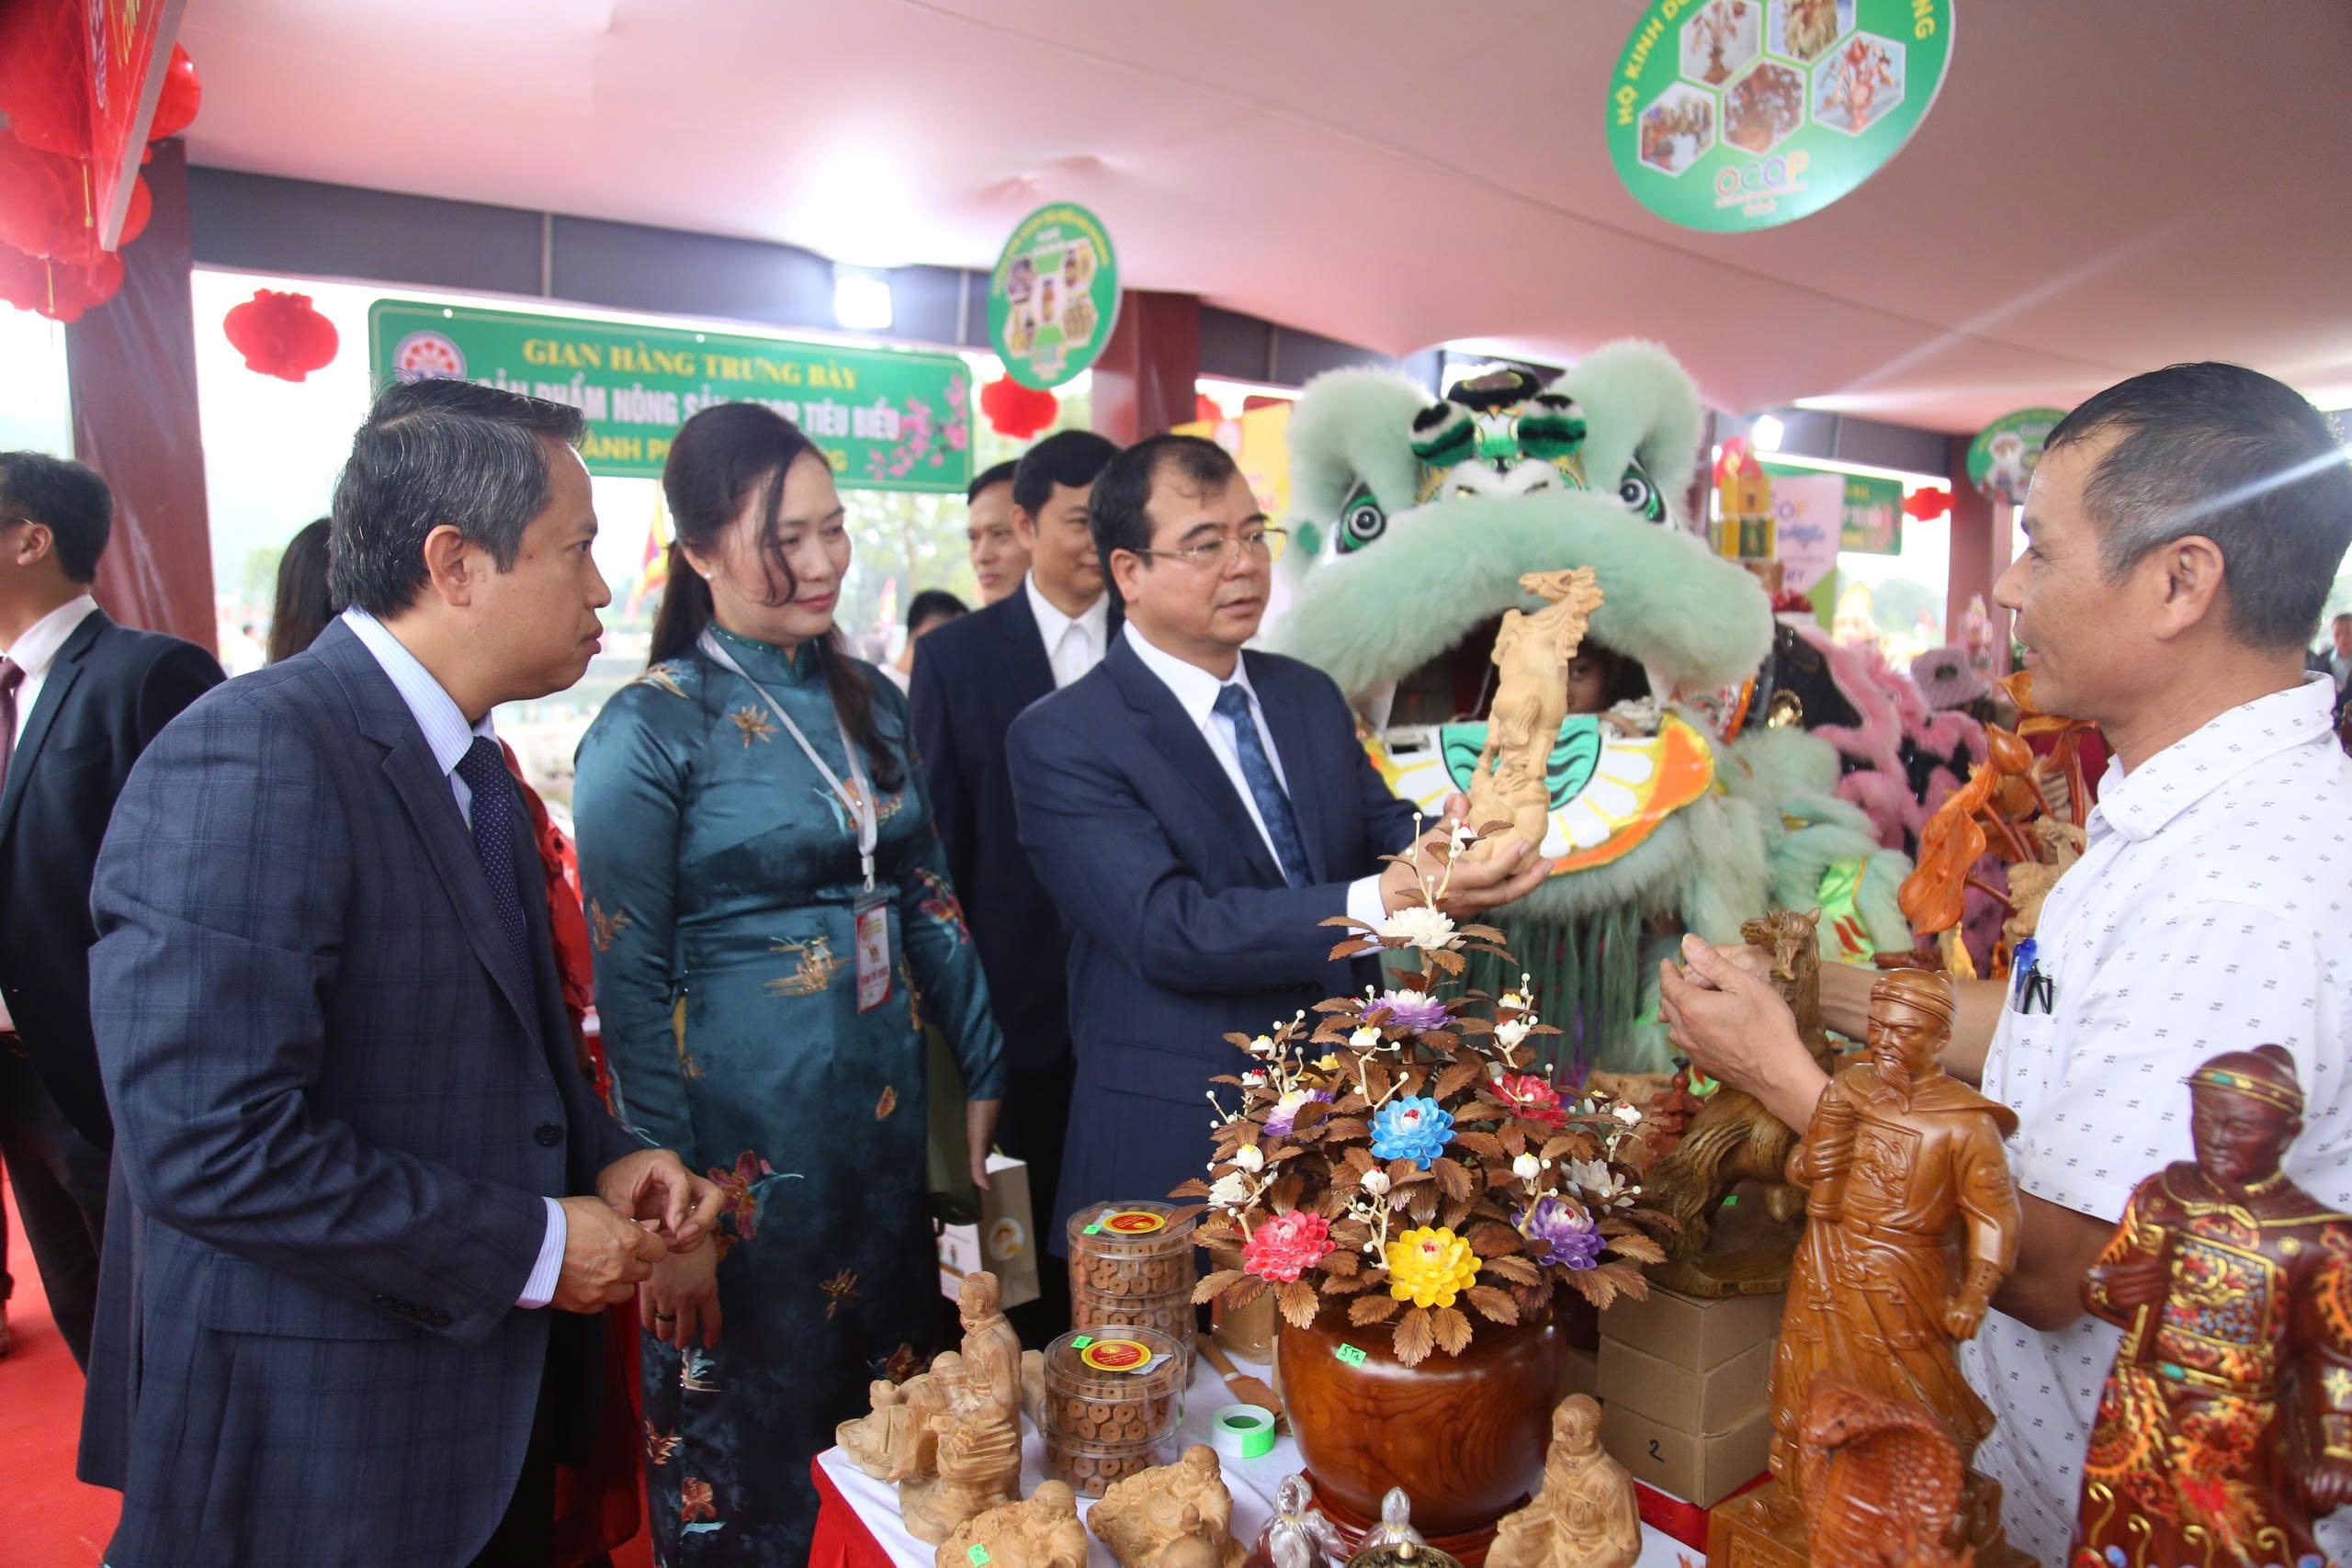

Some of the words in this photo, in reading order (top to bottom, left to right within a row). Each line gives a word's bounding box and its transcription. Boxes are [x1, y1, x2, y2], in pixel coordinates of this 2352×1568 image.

[1624, 17, 1665, 80] KINH
[523, 337, 602, 367] GIAN
[609, 341, 696, 378] HÀNG
[808, 359, 860, 390] BÀY
[612, 381, 679, 425] NÔNG
[1649, 1438, 1665, 1463] 2
